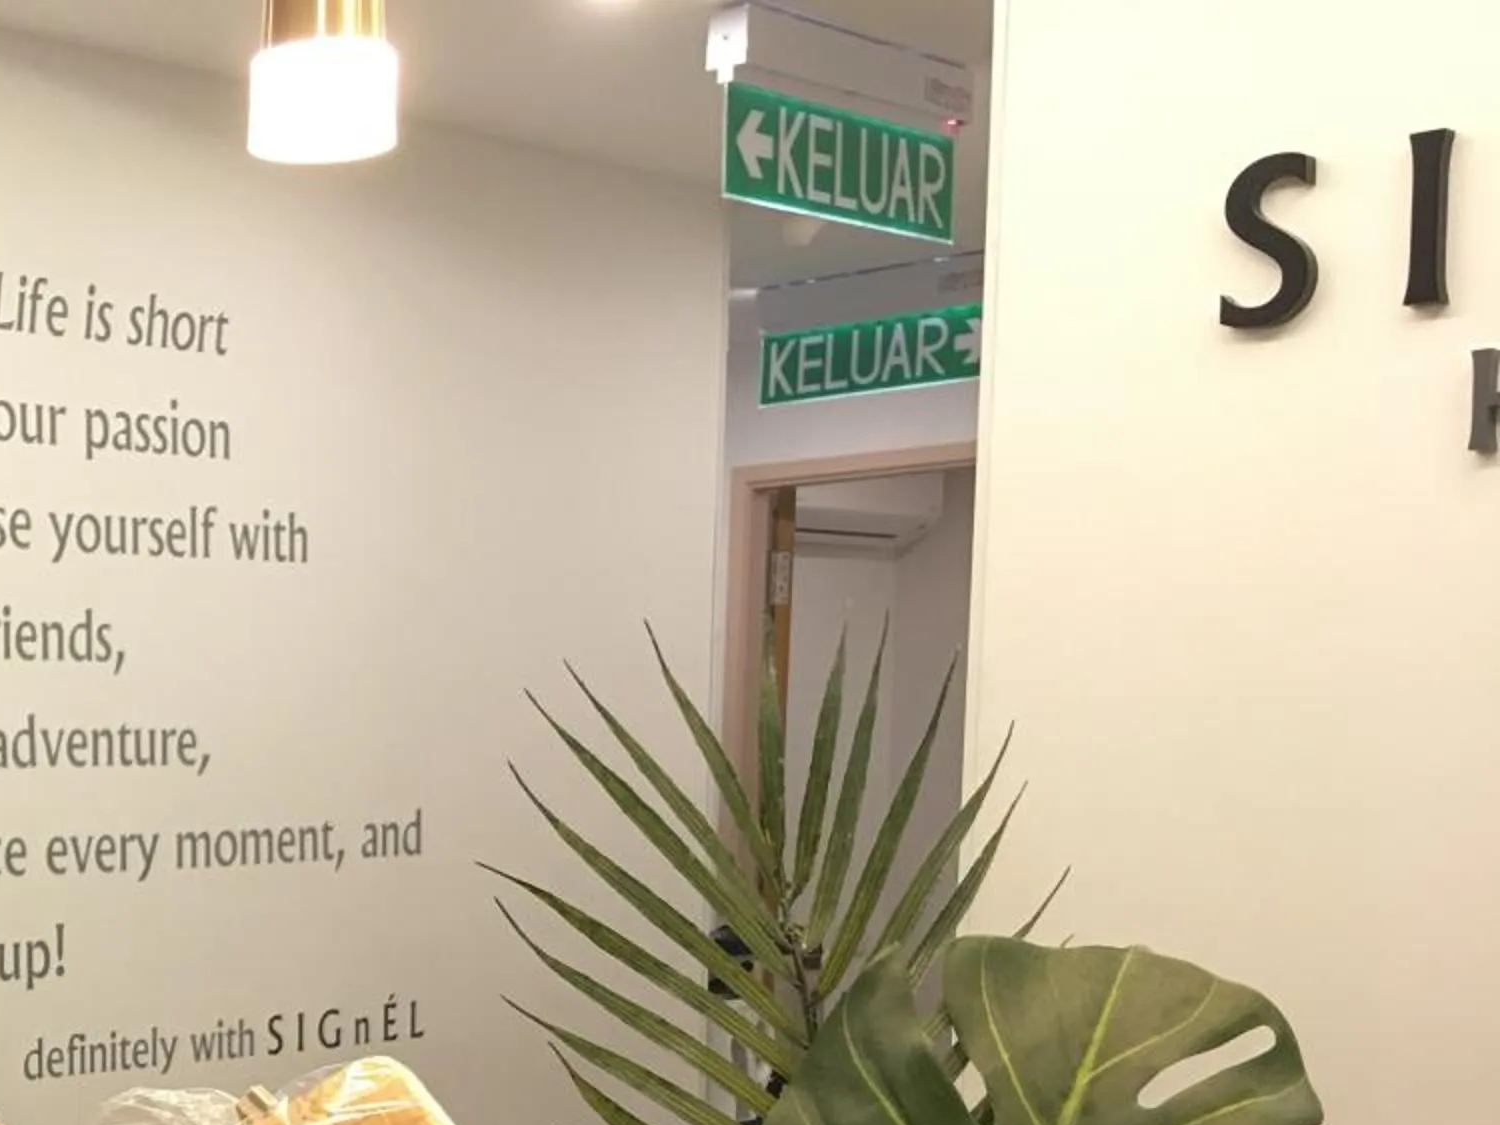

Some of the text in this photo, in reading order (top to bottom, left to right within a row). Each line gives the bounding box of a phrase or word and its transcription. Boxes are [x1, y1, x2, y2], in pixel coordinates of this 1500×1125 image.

[776, 106, 945, 229] KELUAR
[84, 283, 114, 343] is
[126, 293, 229, 356] short
[767, 317, 948, 397] KELUAR
[85, 399, 231, 460] passion
[48, 505, 218, 564] yourself
[228, 508, 309, 564] with
[46, 828, 160, 882] every
[176, 817, 346, 872] moment,
[361, 808, 423, 859] and
[23, 1027, 179, 1081] definitely
[190, 1018, 256, 1063] with
